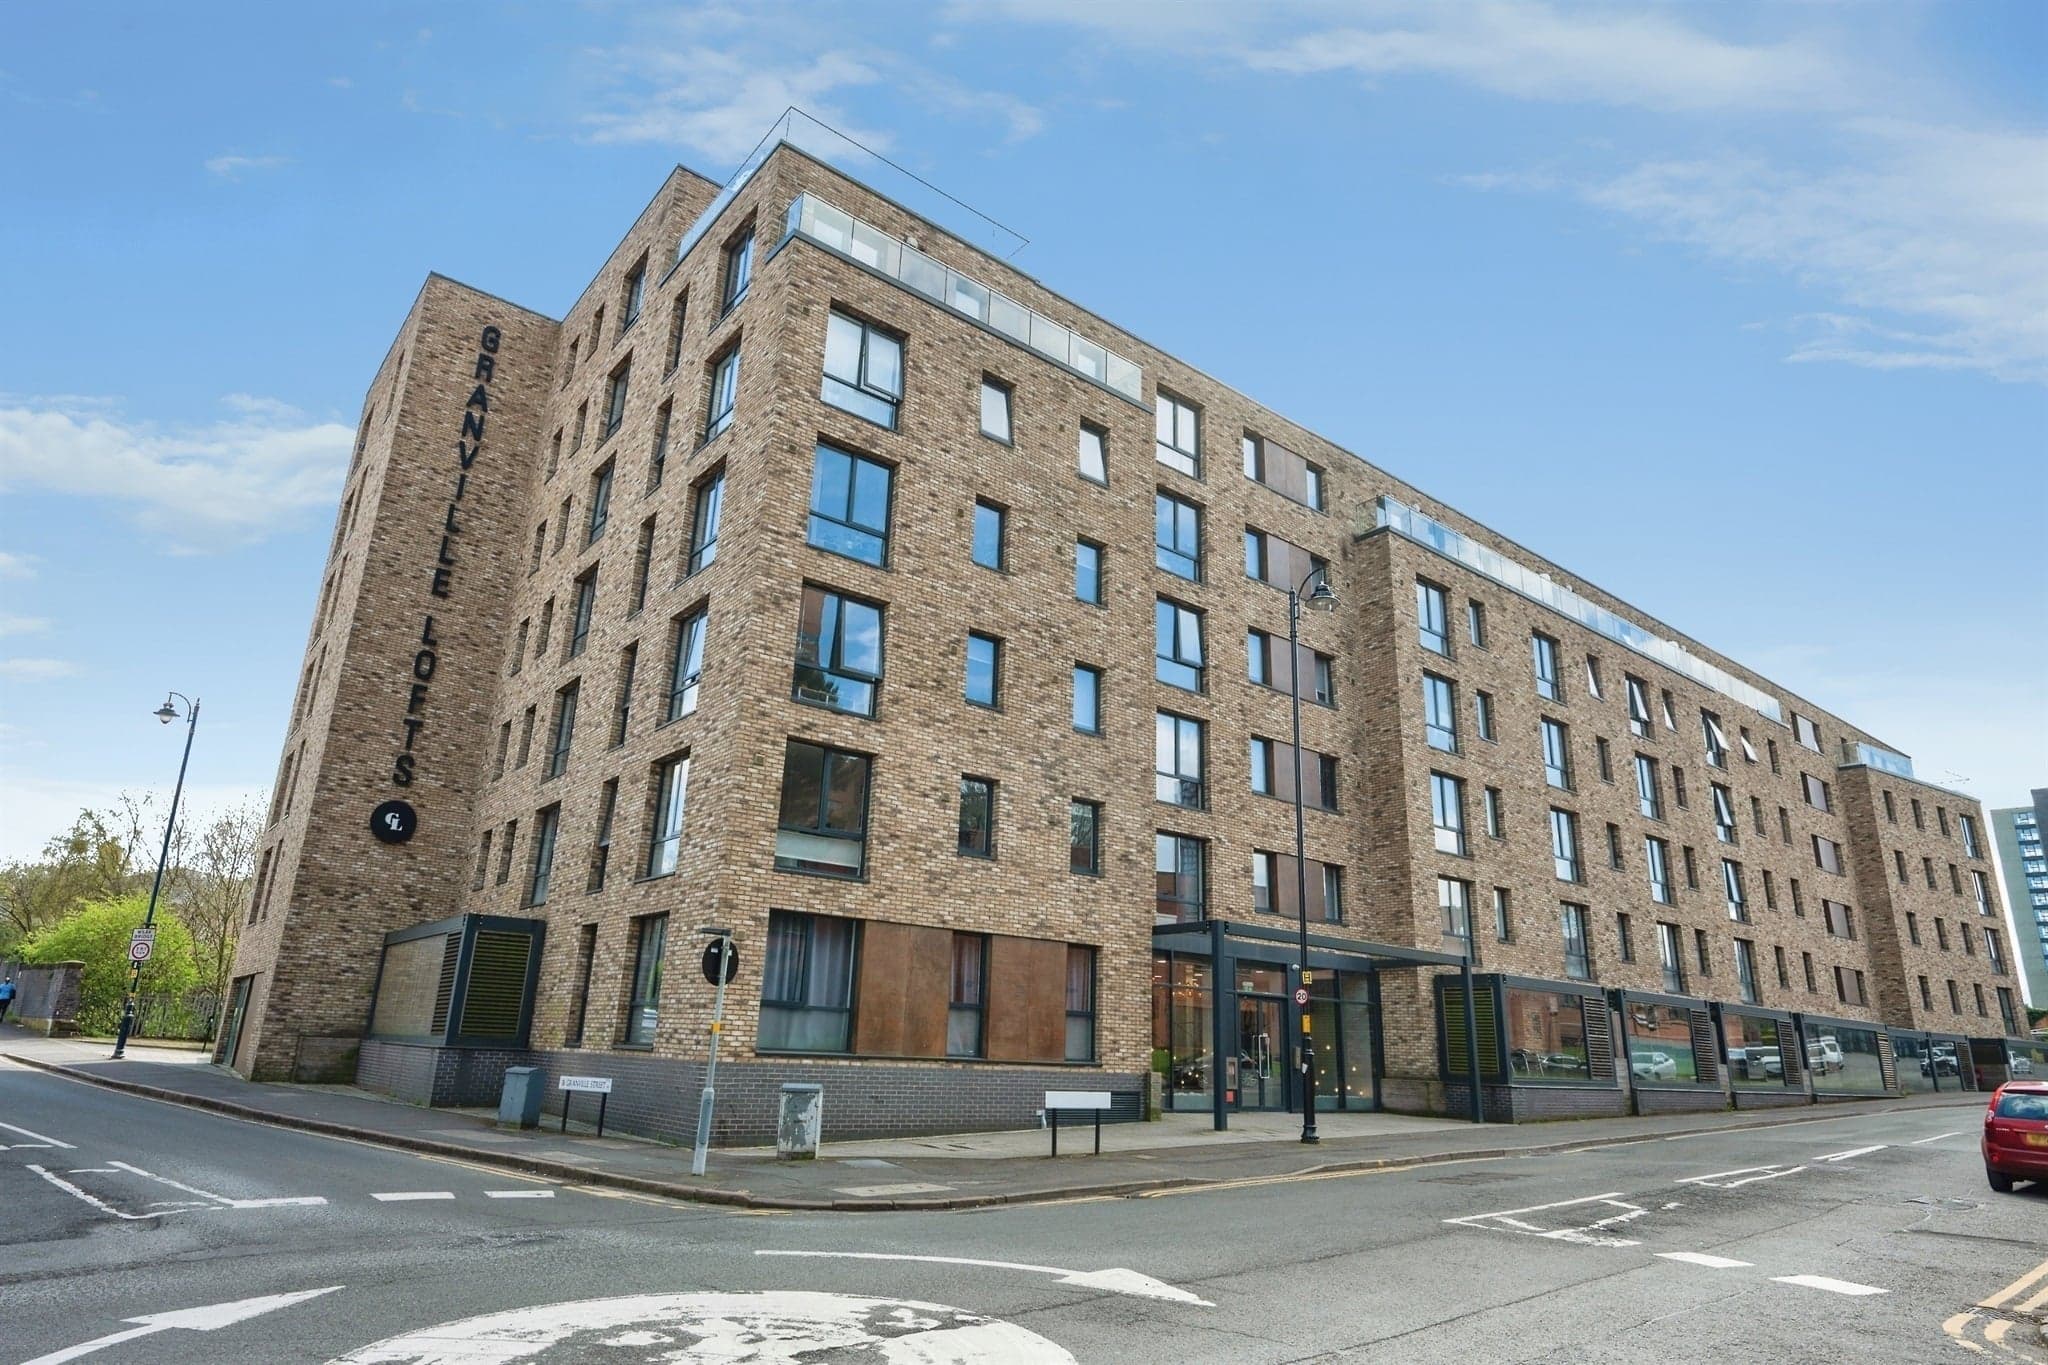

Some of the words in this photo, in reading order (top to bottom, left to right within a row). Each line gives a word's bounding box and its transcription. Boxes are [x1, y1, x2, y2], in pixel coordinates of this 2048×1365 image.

[431, 325, 501, 599] GRANVILLE
[391, 615, 437, 788] LOFTS
[1297, 993, 1306, 1001] 20
[591, 1080, 606, 1089] STREET
